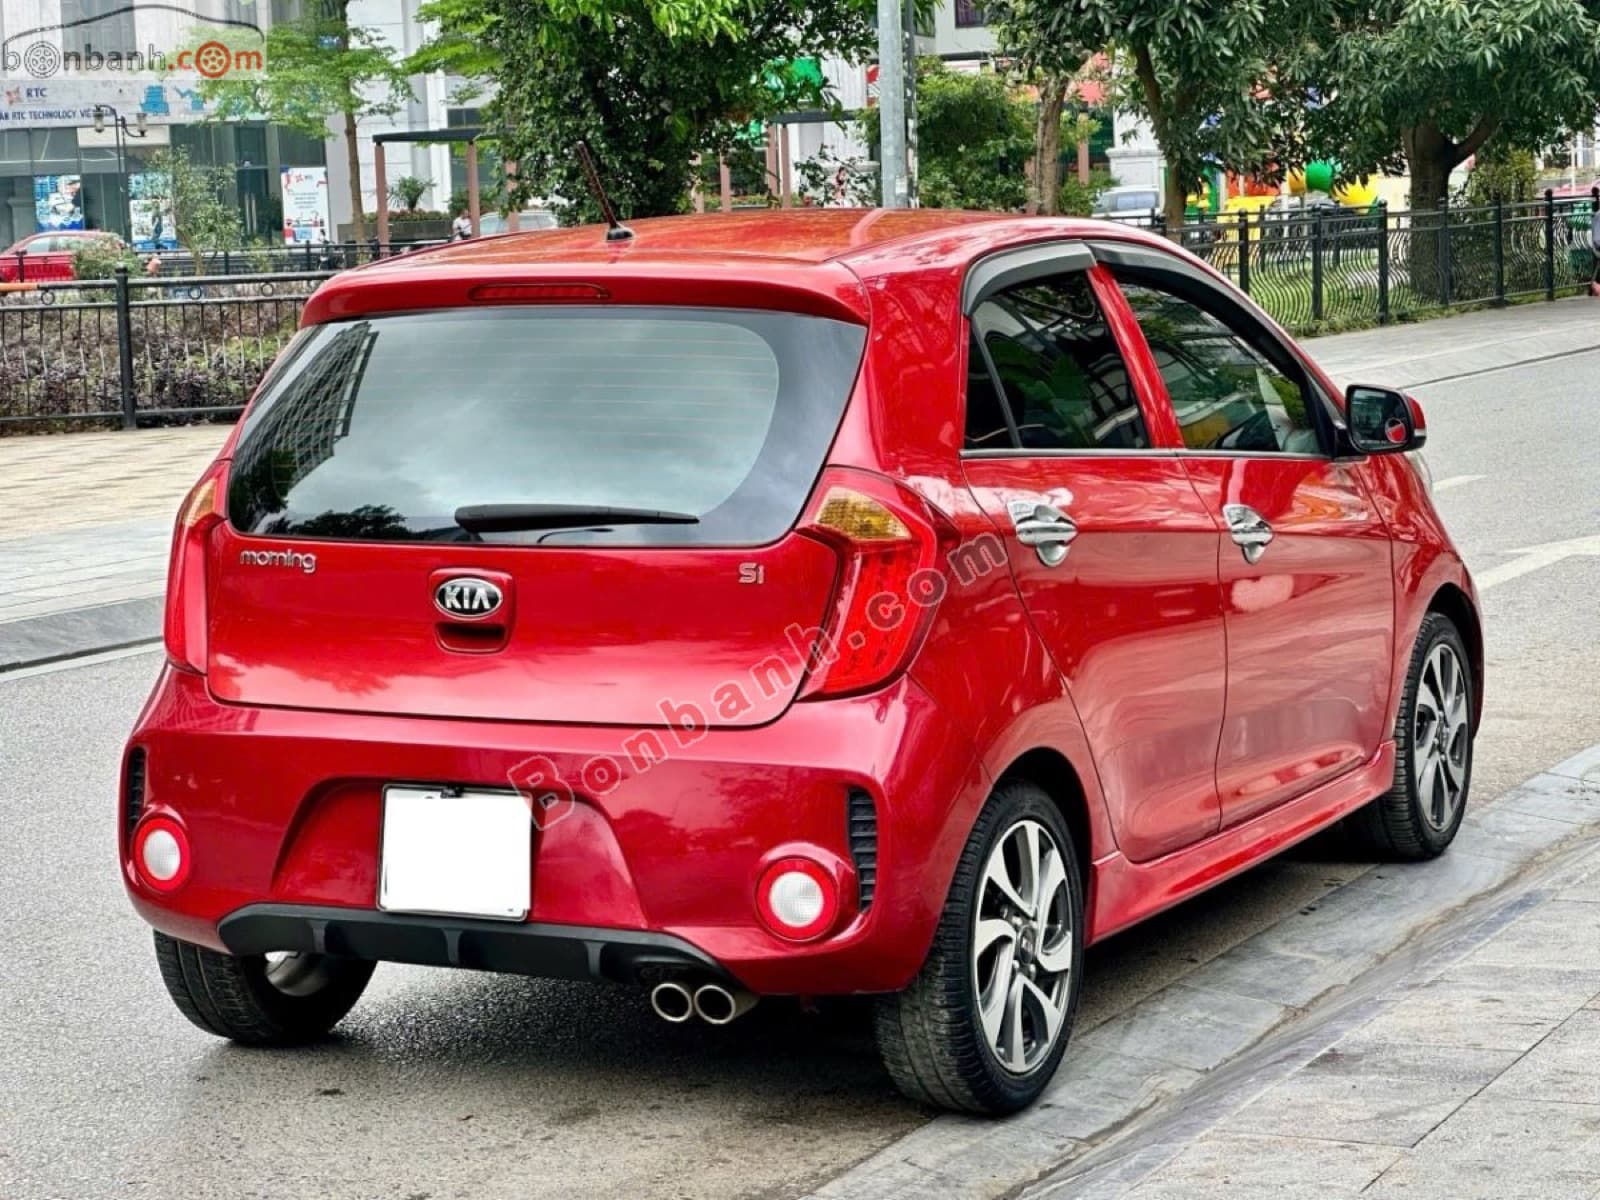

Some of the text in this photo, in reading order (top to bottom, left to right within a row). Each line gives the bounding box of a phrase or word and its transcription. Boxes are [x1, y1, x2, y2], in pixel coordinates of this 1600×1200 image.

[26, 87, 47, 98] RTC
[29, 110, 76, 120] TECHNOLOGY
[240, 548, 316, 574] morning
[444, 585, 491, 610] KIA
